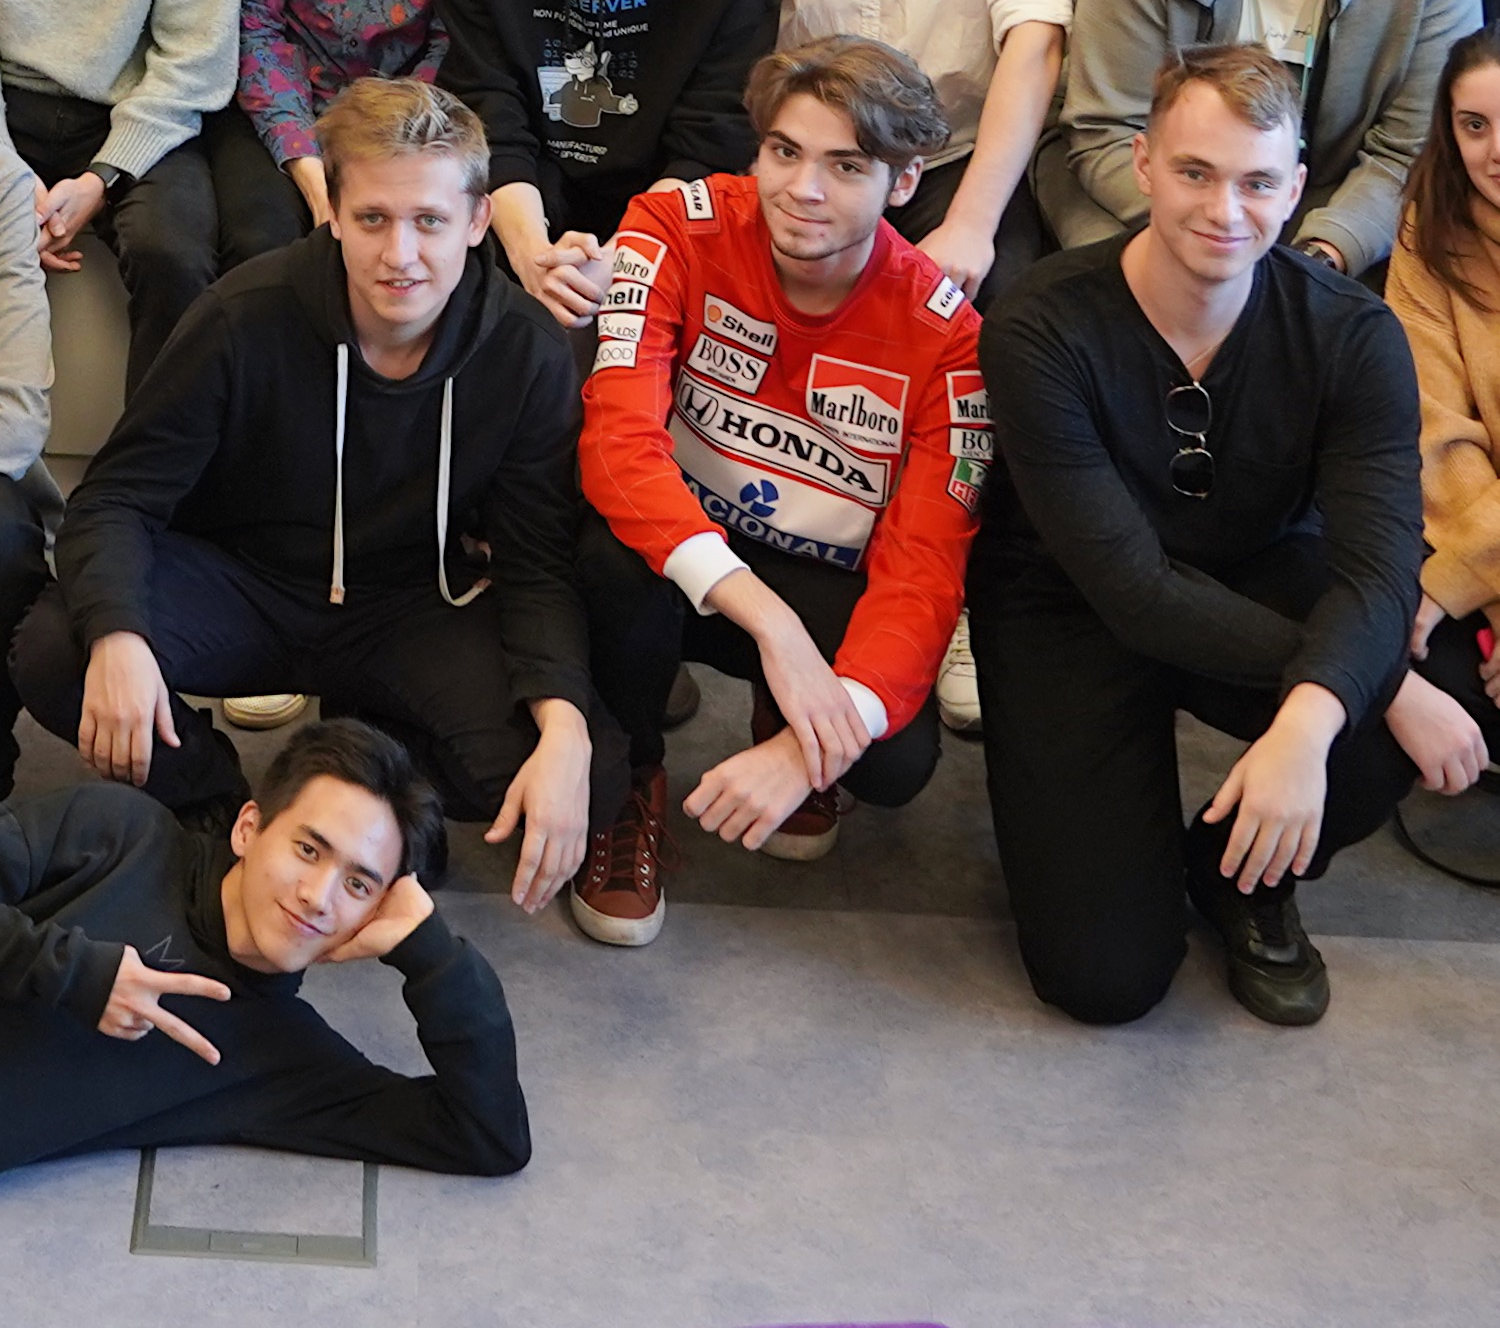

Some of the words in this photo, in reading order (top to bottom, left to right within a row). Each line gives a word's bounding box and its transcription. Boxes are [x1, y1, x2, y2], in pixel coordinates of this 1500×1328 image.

[612, 252, 650, 280] lboro
[721, 314, 774, 349] Shell
[697, 336, 762, 382] BOSS
[811, 390, 900, 435] Marlboro
[716, 408, 879, 495] HONDA
[687, 479, 847, 566] ACIONAL
